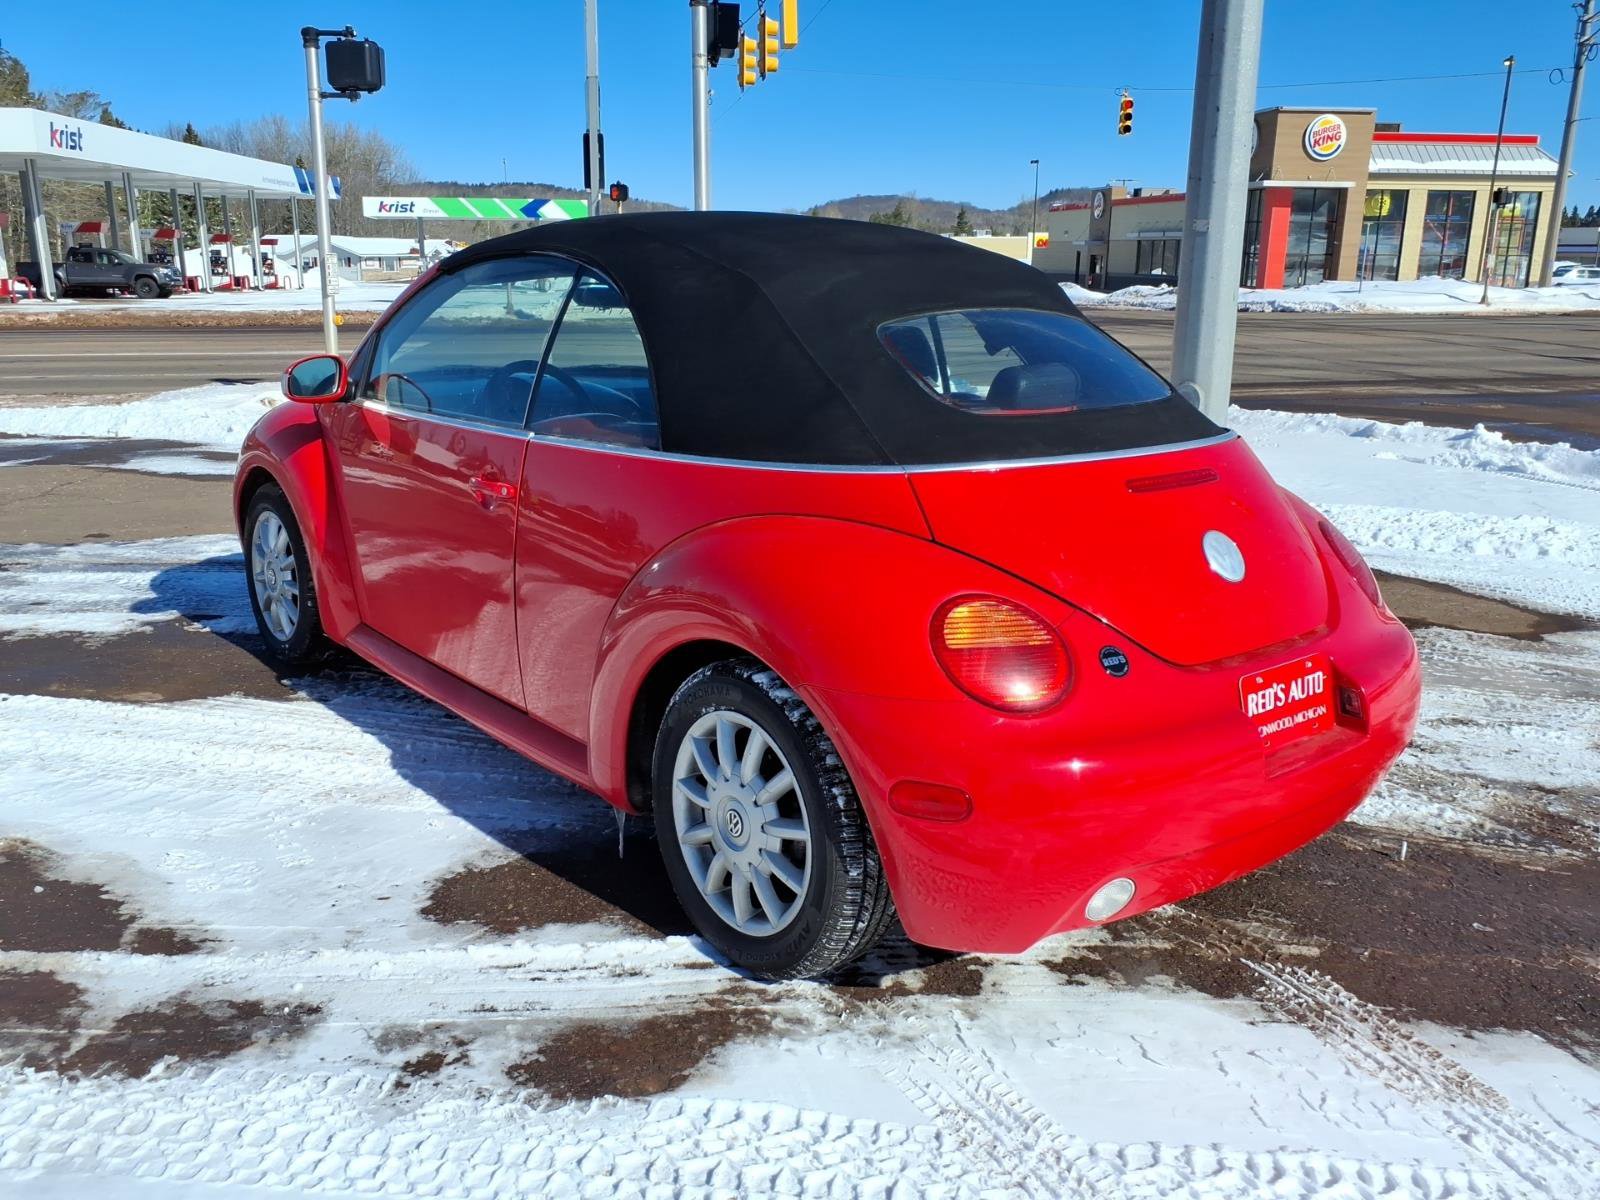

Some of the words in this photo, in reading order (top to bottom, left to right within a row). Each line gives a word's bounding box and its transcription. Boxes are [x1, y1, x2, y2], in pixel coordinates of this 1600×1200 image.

[50, 121, 83, 152] krist
[1312, 124, 1341, 139] BURGER
[1312, 132, 1342, 149] KING
[378, 201, 416, 213] krist
[1247, 682, 1286, 717] RED'S
[1287, 671, 1324, 703] AUTO
[1292, 704, 1327, 725] MICHIGAN
